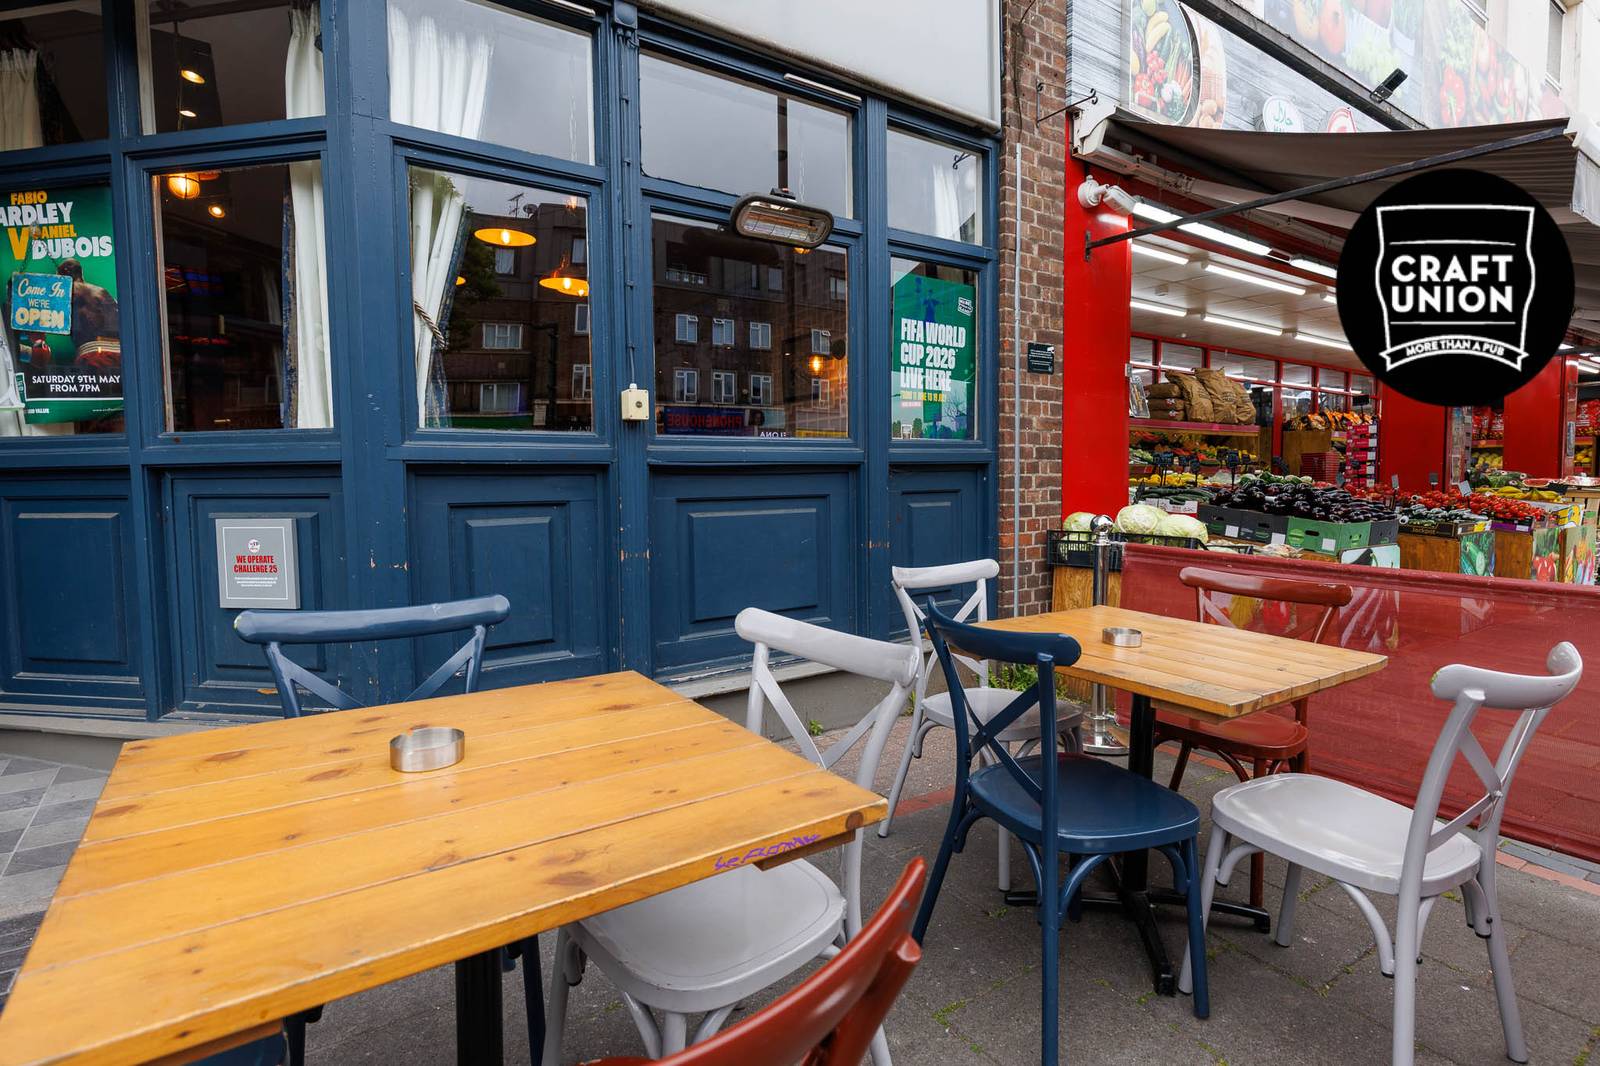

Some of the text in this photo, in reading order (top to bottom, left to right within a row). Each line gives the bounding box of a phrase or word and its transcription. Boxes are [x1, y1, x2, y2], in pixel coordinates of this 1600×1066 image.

[10, 190, 48, 205] FABIO
[7, 227, 30, 260] V
[31, 235, 113, 260] DUBOIS
[17, 278, 66, 298] Come In
[27, 297, 51, 309] WE'RE
[15, 307, 65, 329] OPEN
[901, 318, 966, 348] FIFA WORLD
[901, 342, 924, 365] CUP
[32, 375, 121, 384] SATURDAY 9TH MAY
[49, 384, 101, 393] FROM 7PM
[900, 366, 952, 391] LIVE HERE
[234, 565, 278, 573] CHALLENGE 25
